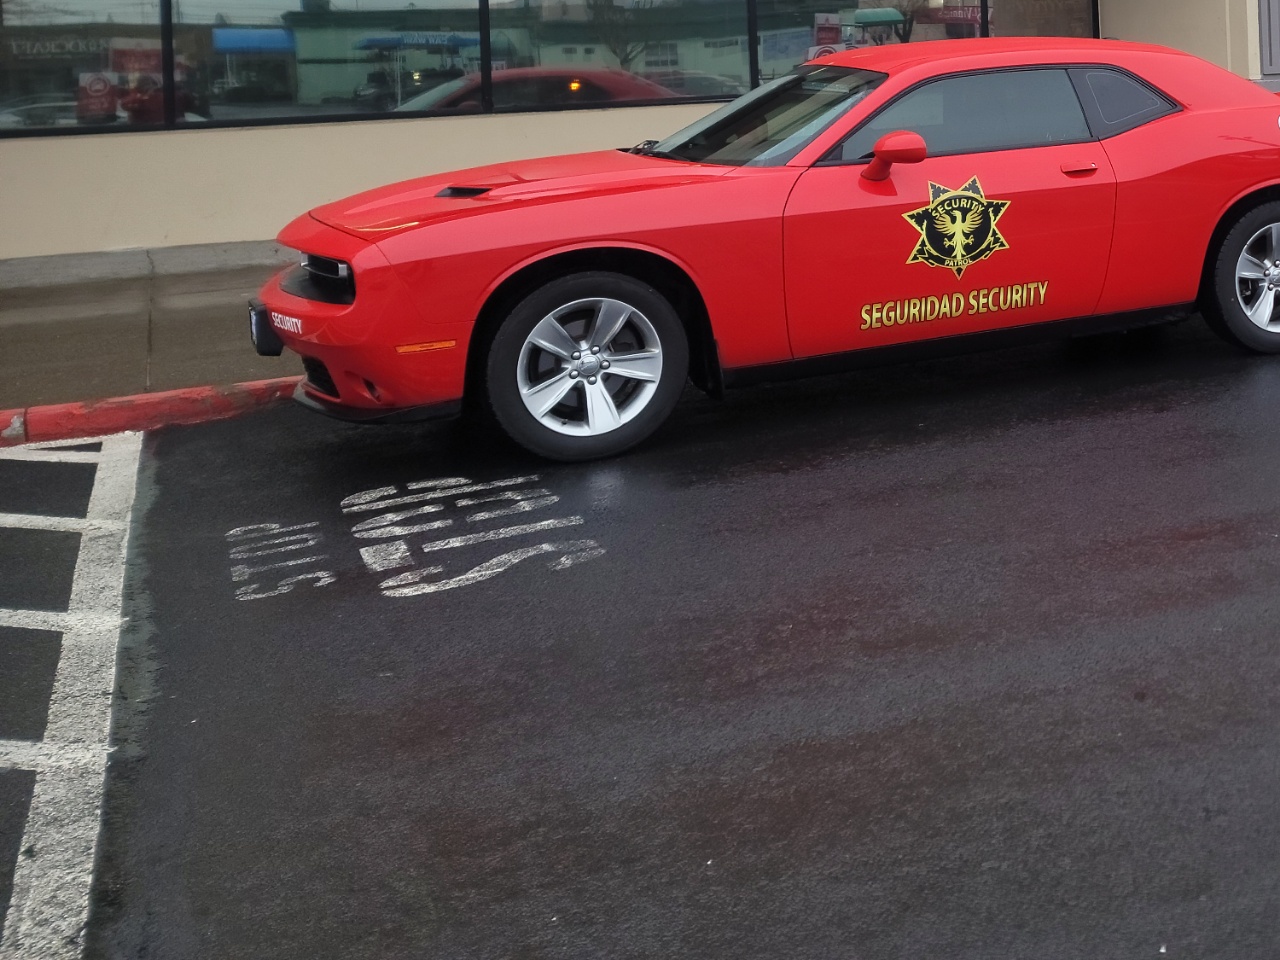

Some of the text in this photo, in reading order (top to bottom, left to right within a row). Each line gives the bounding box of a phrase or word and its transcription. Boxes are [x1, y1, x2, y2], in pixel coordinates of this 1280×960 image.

[931, 198, 985, 220] SECURITY
[944, 257, 973, 267] PATROL
[860, 280, 1049, 330] SEGURIDAD SECURITY
[271, 311, 303, 335] SECURITY
